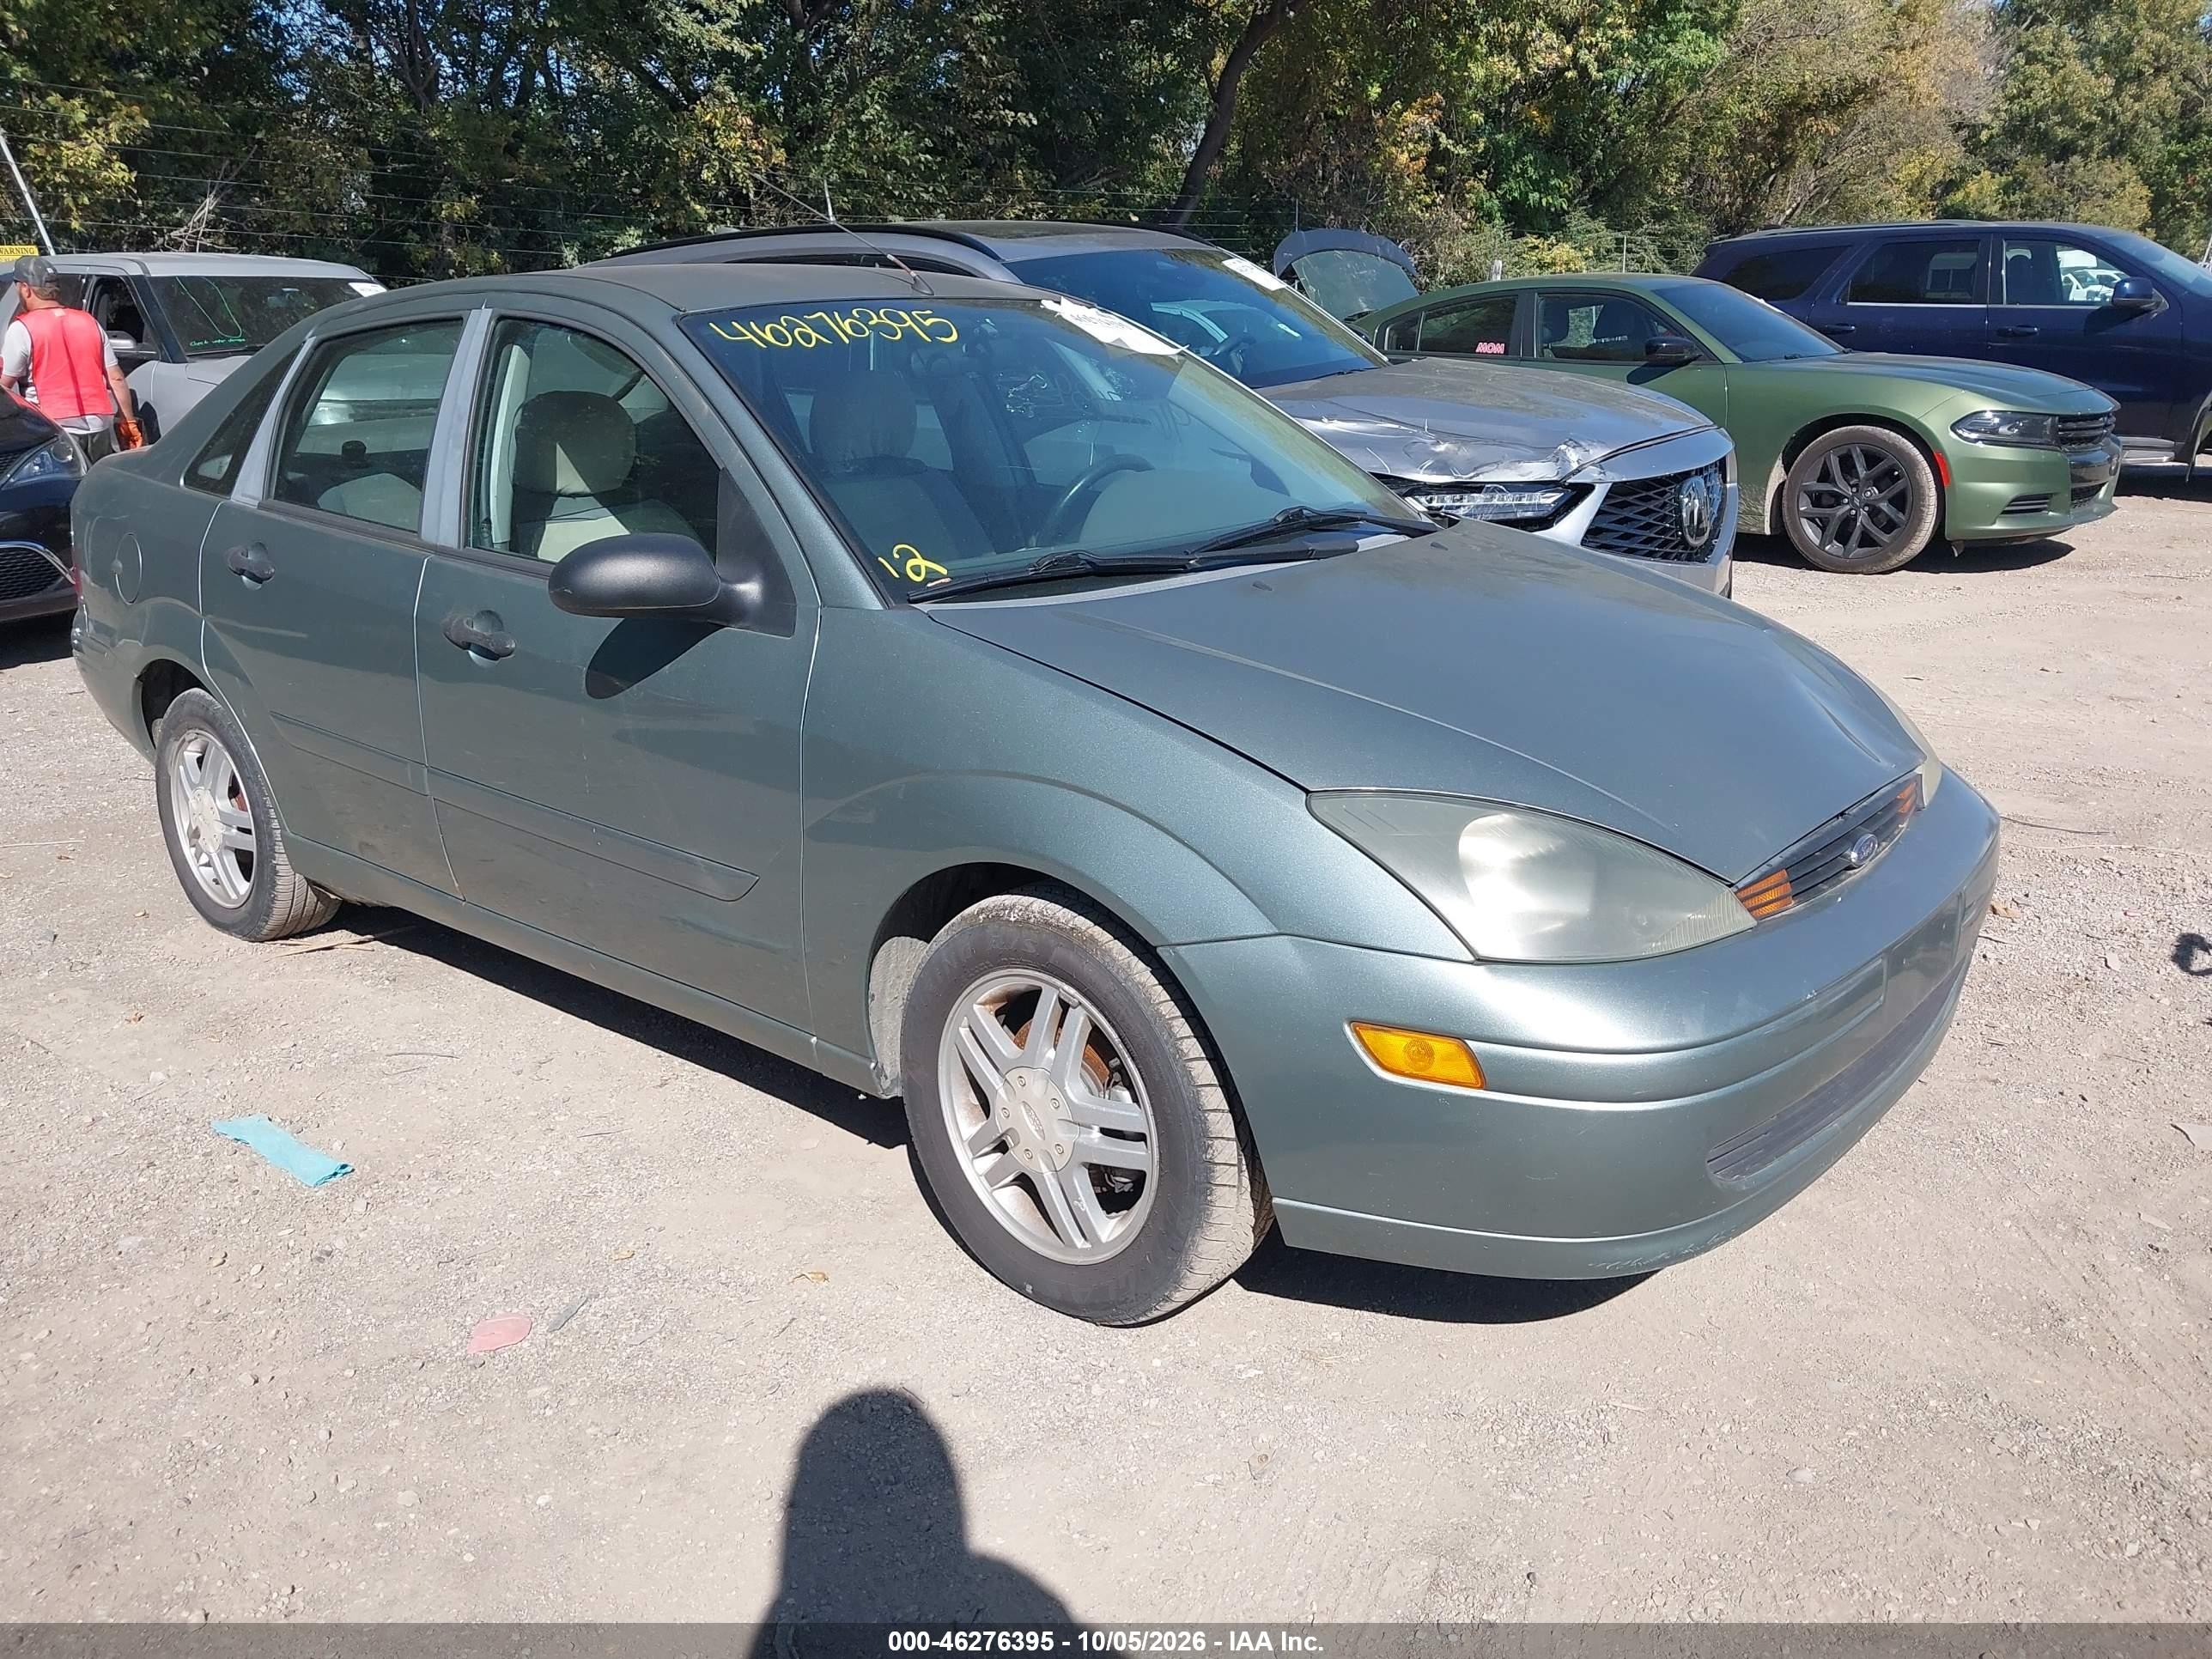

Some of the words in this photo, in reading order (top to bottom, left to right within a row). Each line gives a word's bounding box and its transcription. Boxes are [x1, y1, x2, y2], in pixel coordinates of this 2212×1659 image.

[708, 307, 959, 349] 46276395
[1475, 342, 1505, 354] MOM
[878, 544, 948, 582] 12
